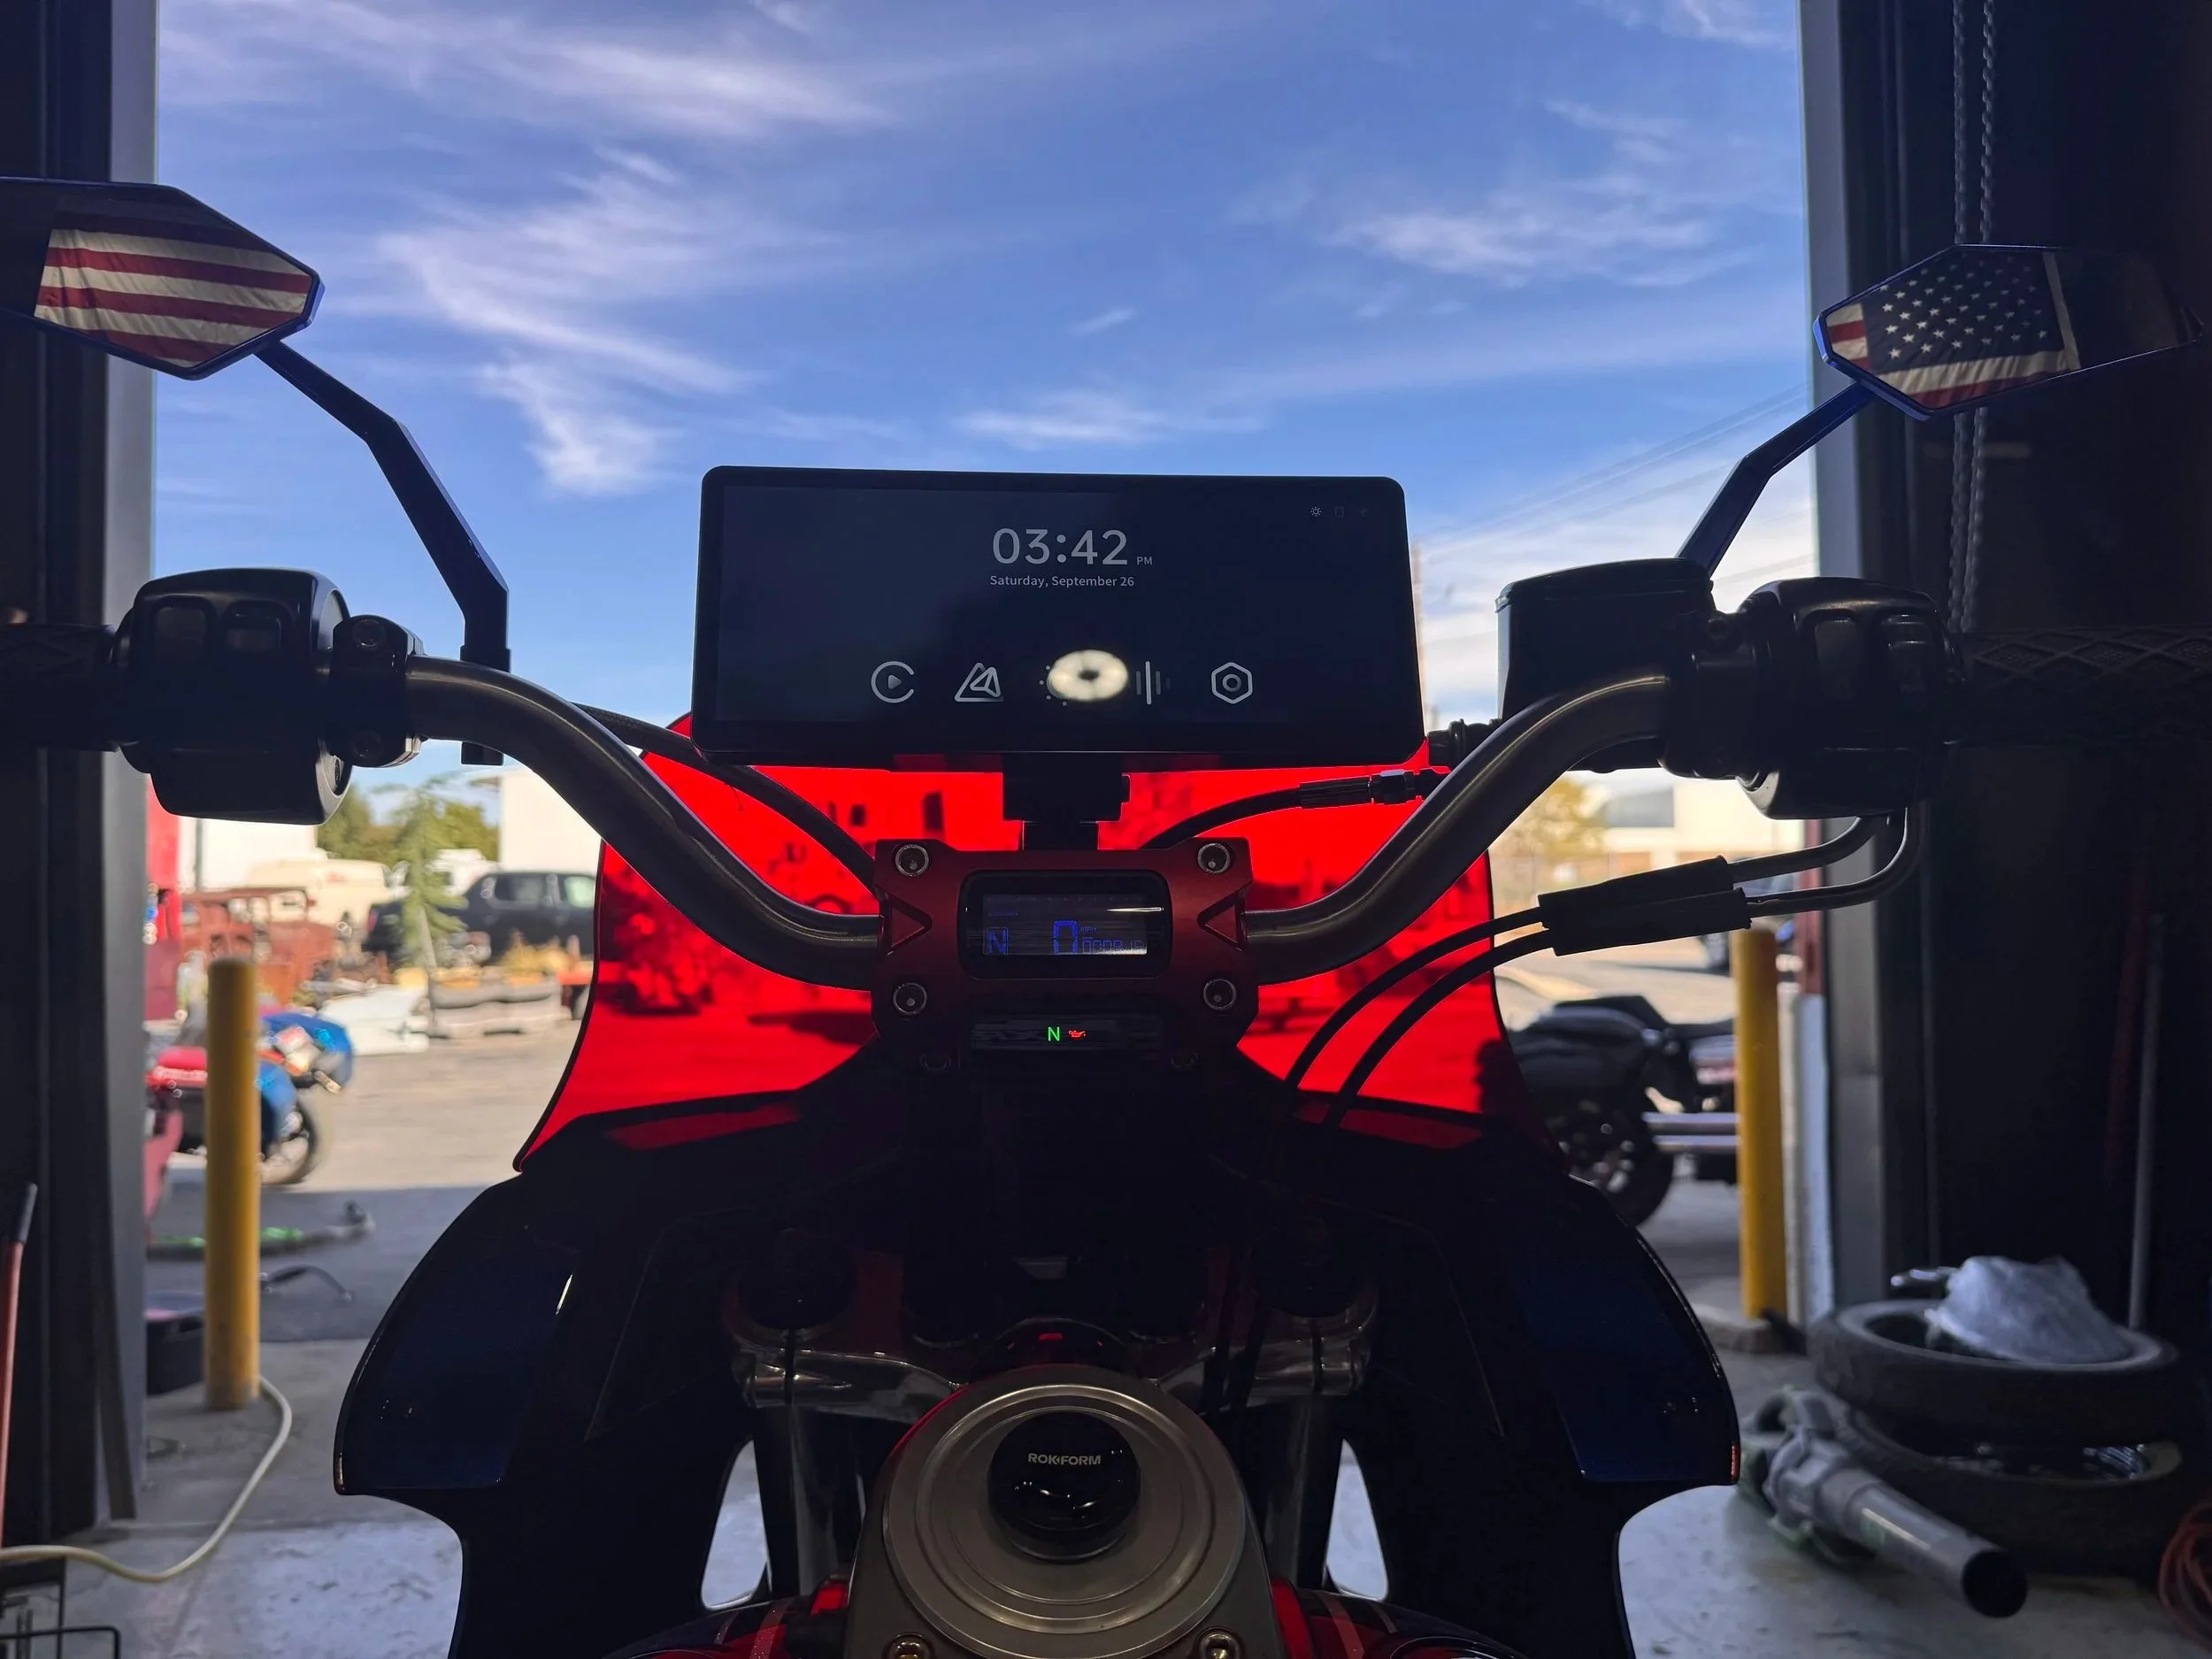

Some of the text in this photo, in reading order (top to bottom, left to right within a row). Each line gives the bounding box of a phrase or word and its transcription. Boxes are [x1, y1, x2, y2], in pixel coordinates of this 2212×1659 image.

[992, 527, 1153, 565] 03:42 PM
[989, 574, 1134, 588] Saturday, September 26
[987, 929, 1006, 955] N
[1047, 1025, 1061, 1042] N
[1028, 1453, 1102, 1466] ROKFORM
